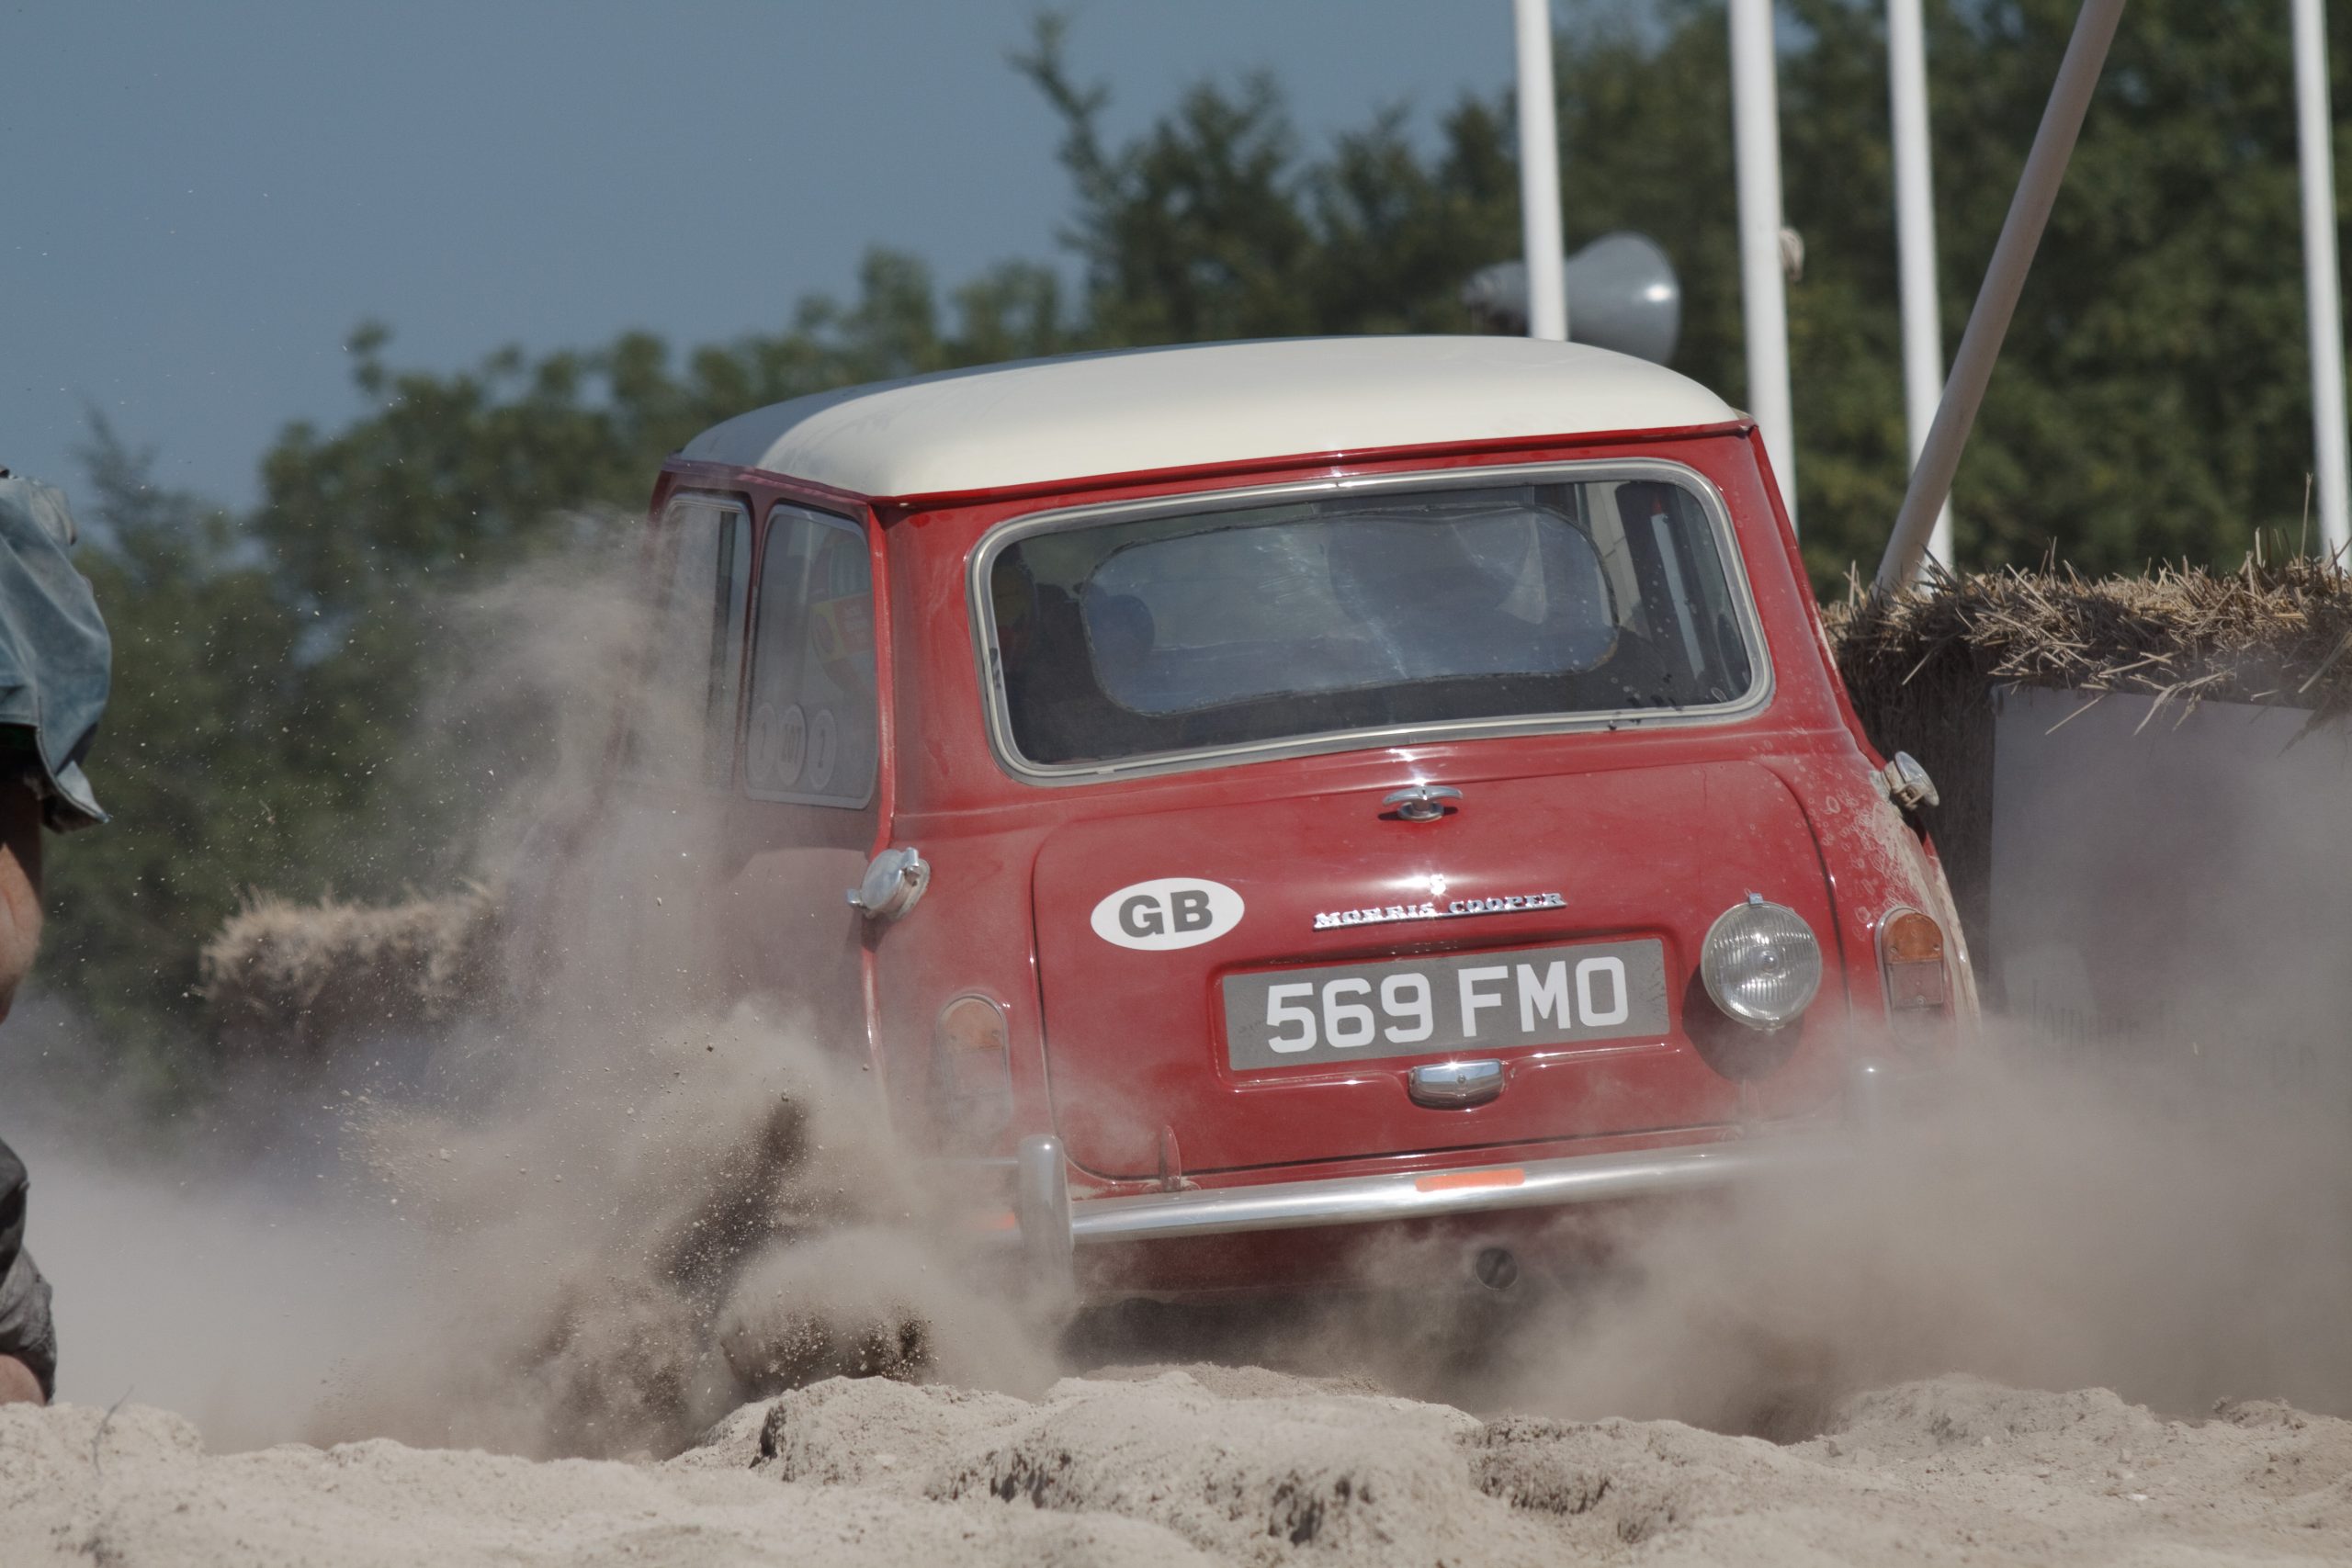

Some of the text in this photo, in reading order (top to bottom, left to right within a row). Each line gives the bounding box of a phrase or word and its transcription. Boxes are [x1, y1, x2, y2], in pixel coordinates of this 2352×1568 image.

[1117, 888, 1214, 939] GB
[1313, 893, 1565, 928] MORRIS COOPER
[1266, 955, 1630, 1054] 569 FMO
